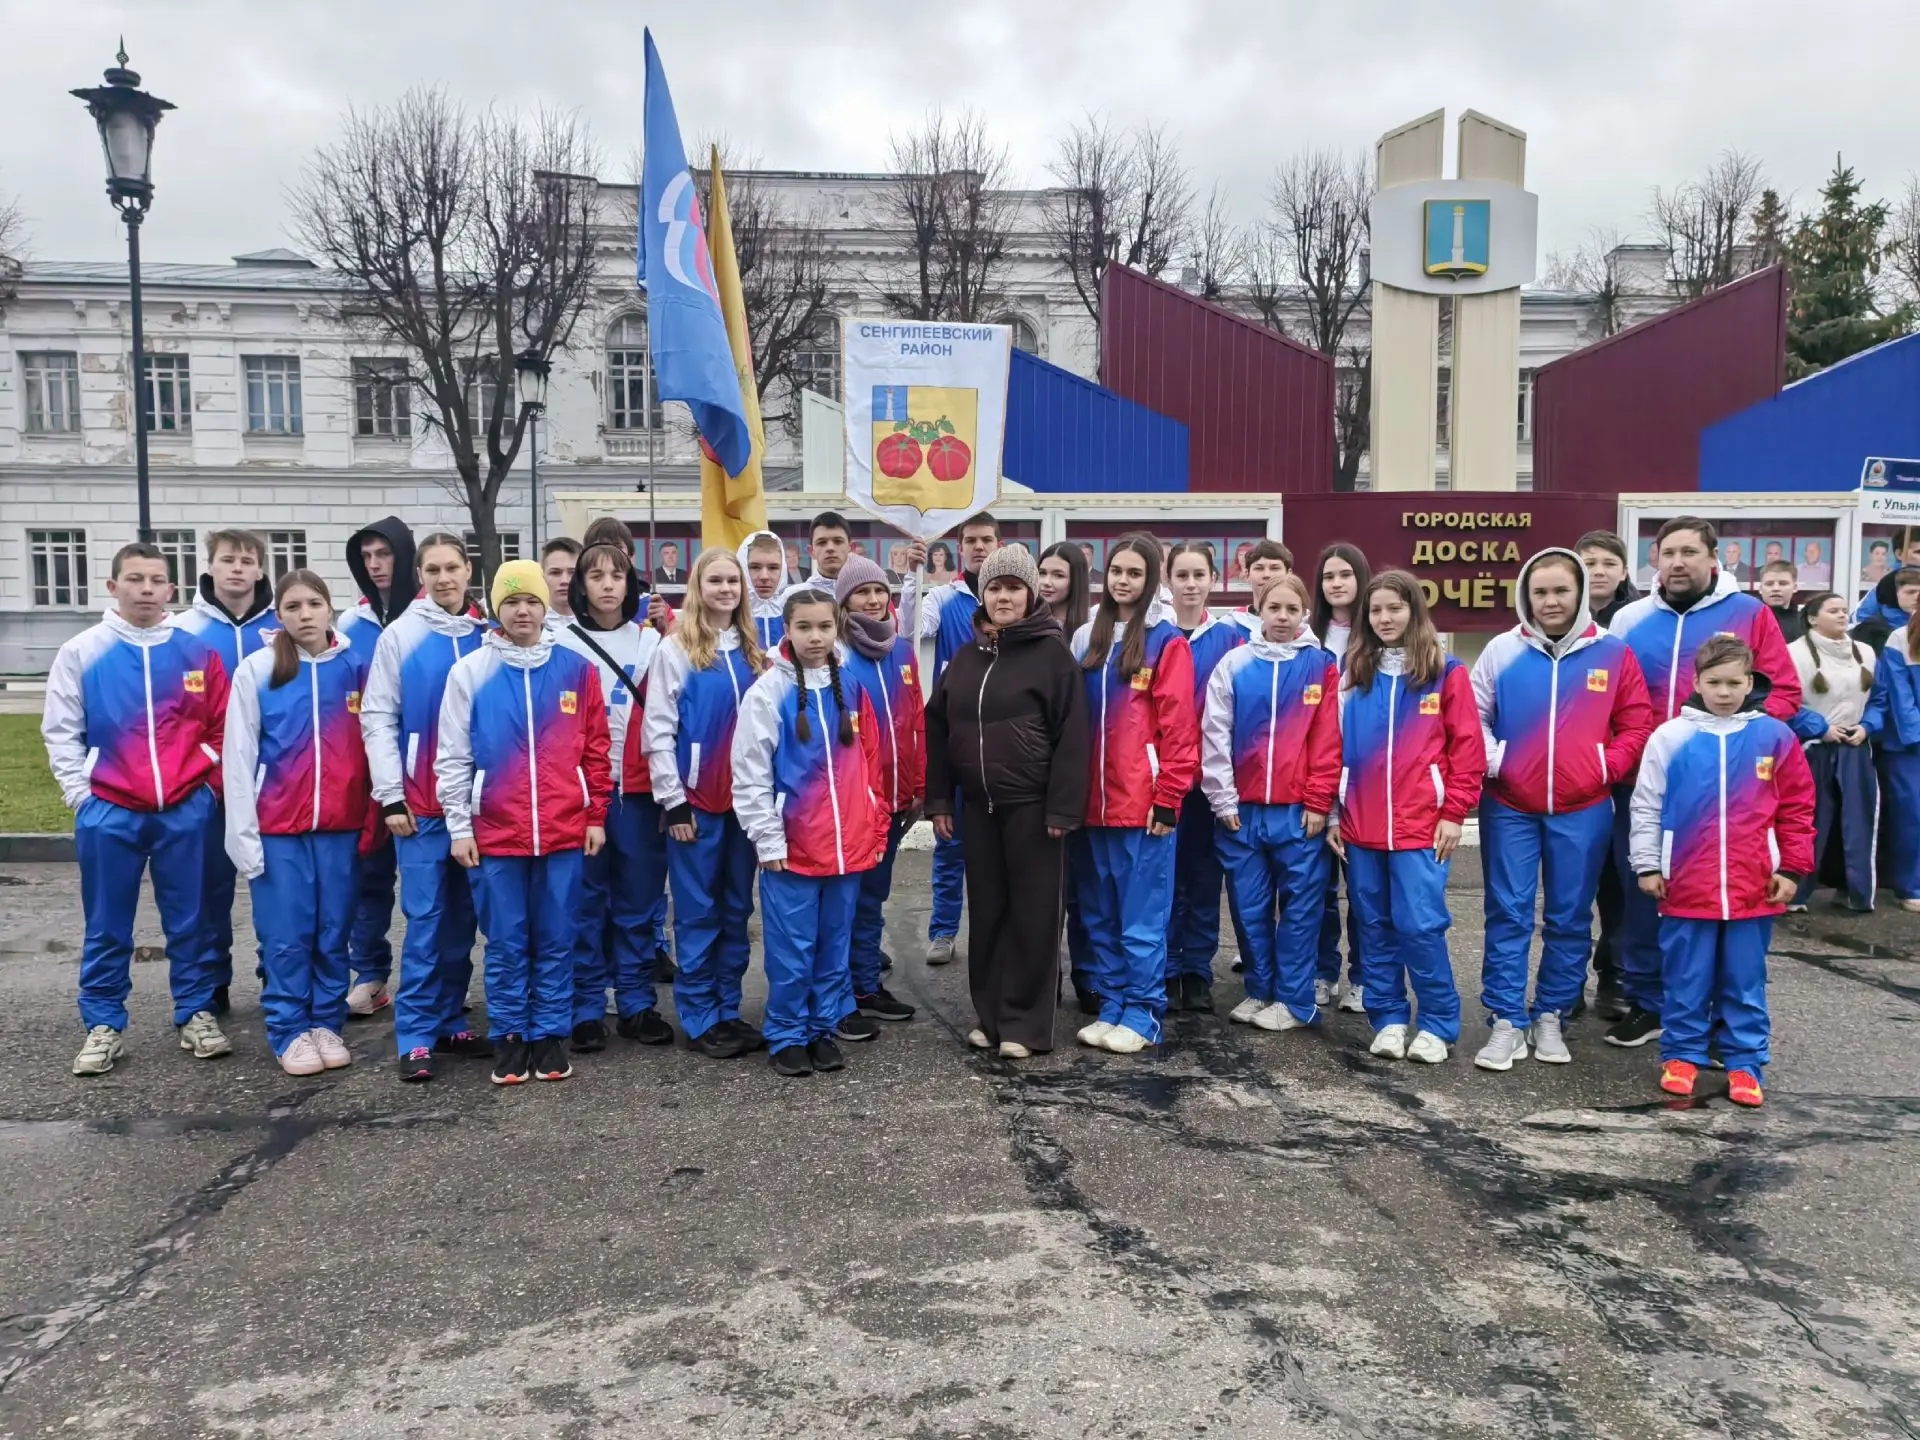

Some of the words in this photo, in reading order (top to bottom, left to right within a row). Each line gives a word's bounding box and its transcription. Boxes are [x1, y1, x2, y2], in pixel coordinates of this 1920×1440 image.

[860, 325, 993, 341] СЕНГИЛЕЕВСКИЙ
[900, 342, 953, 356] РАЙОН
[1402, 512, 1532, 529] ГОРОДСКАЯ
[1412, 540, 1521, 565] ДОСКА
[1417, 572, 1517, 608] ОЧЁТ
